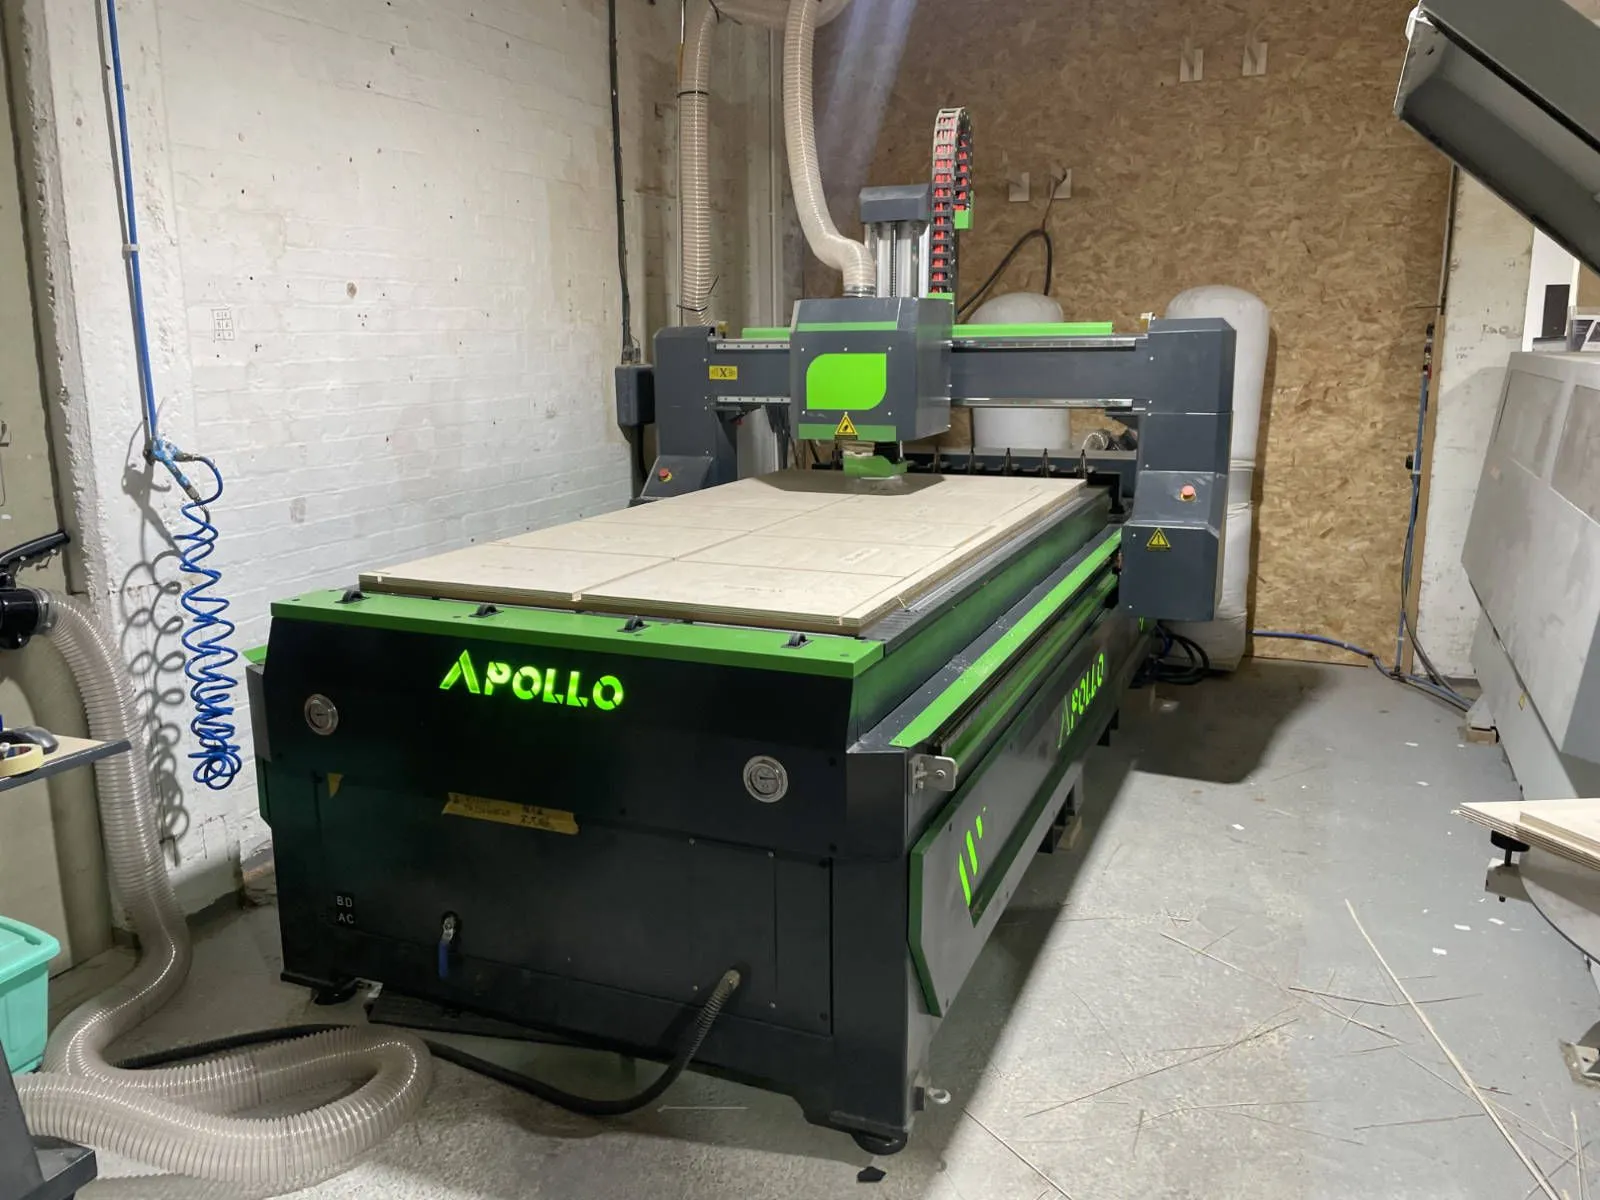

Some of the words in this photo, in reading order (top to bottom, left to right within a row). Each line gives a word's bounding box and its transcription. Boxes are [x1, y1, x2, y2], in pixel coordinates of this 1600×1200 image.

[720, 367, 729, 378] X
[439, 649, 624, 711] APOLLO
[1057, 652, 1105, 750] APOLLO
[338, 911, 355, 924] AC
